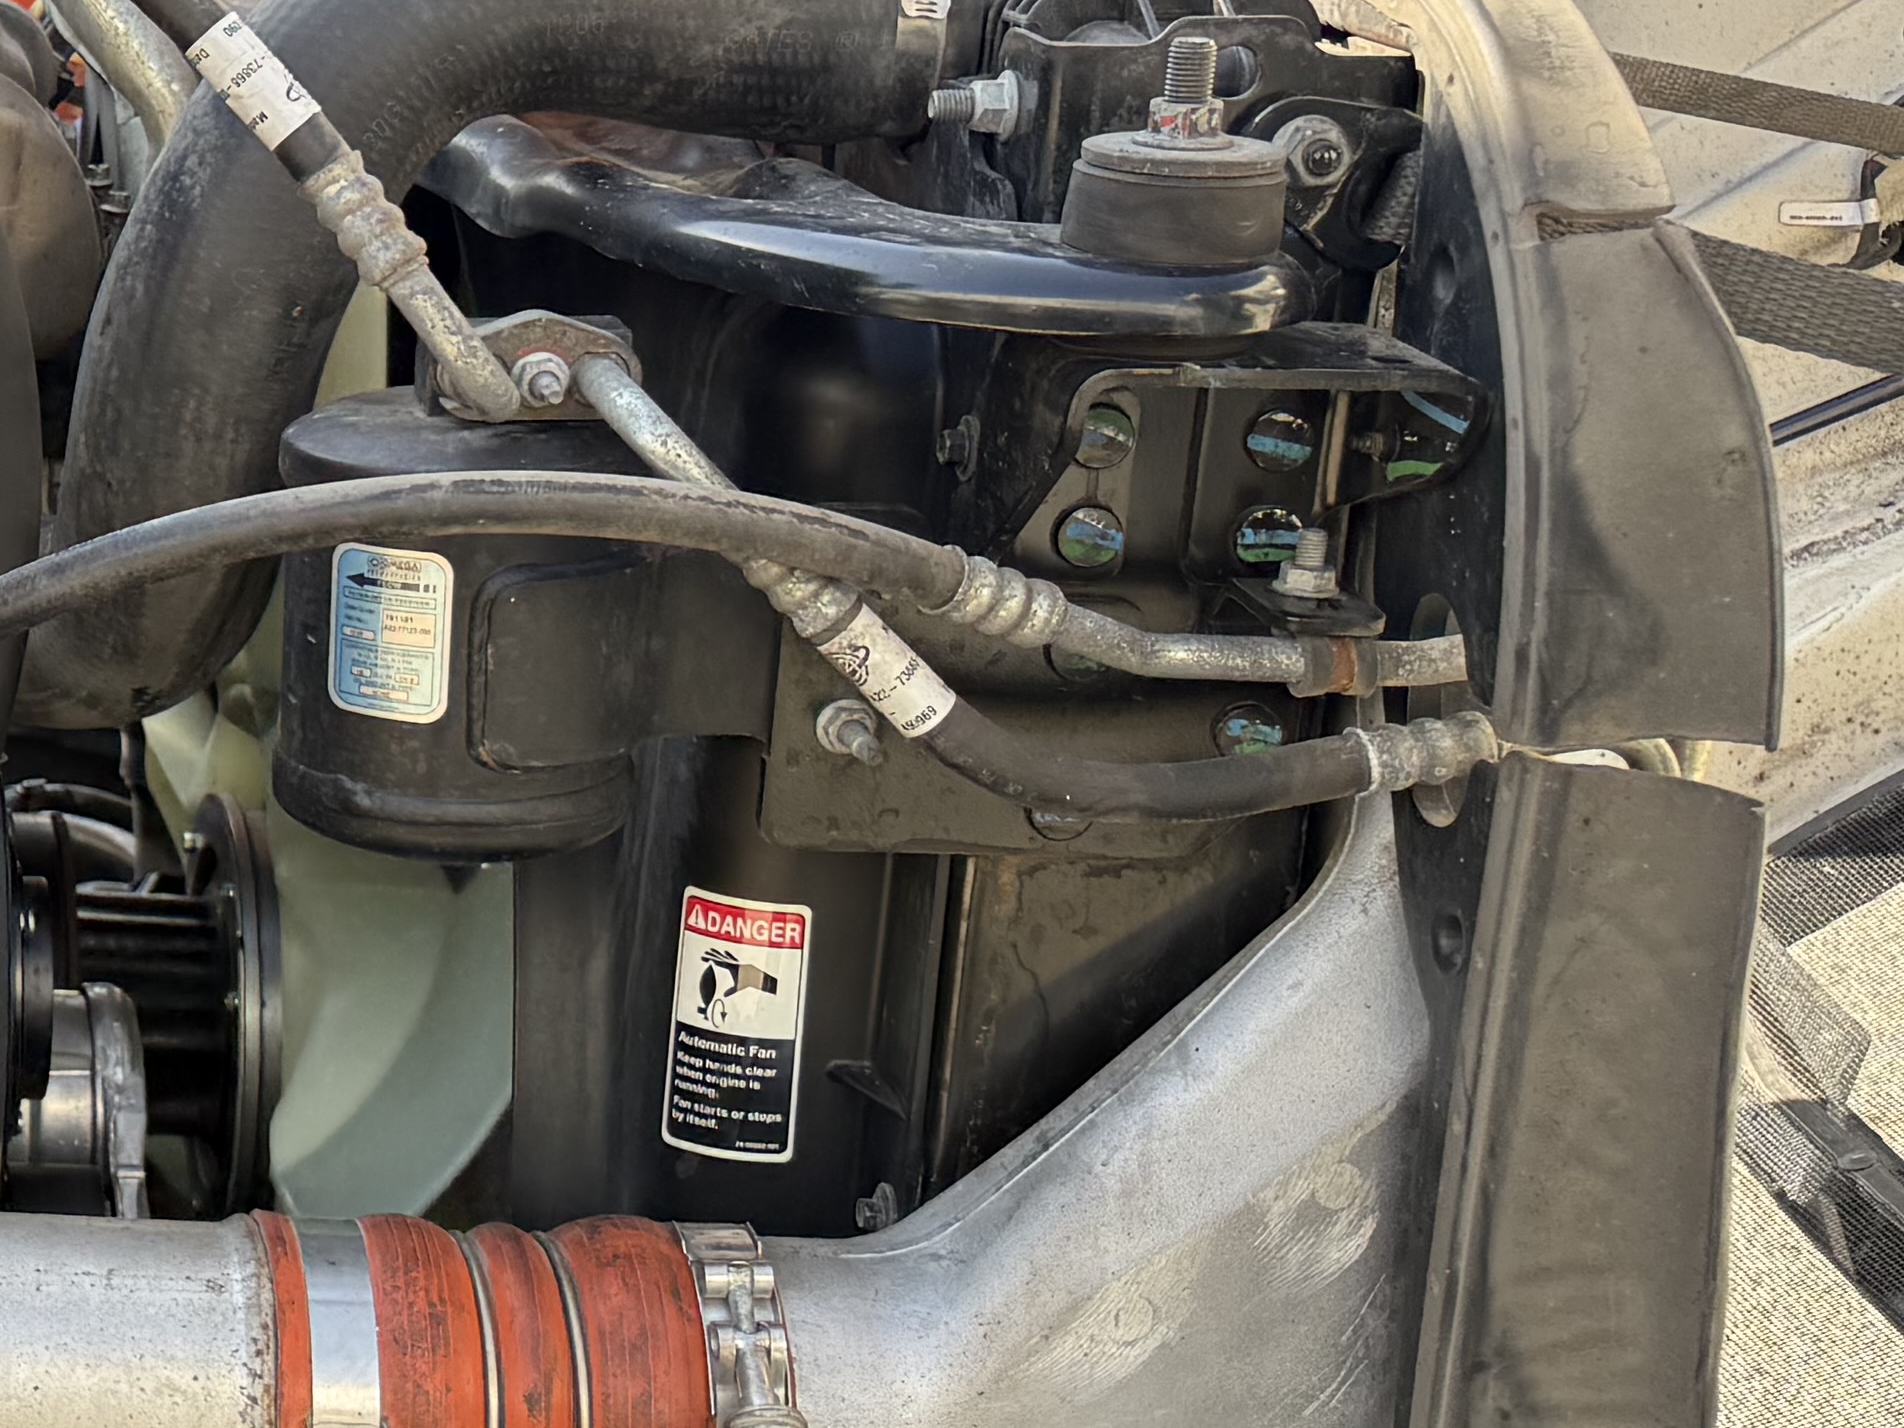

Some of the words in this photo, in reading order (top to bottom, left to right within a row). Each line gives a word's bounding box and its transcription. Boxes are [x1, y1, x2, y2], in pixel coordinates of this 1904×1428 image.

[707, 911, 802, 945] DANGER
[678, 1030, 746, 1057] Automatic
[748, 1045, 777, 1060] Fan
[675, 1065, 703, 1081] when
[705, 1073, 747, 1088] engine
[749, 1079, 761, 1090] is
[676, 1050, 703, 1068] Keep
[705, 1058, 743, 1075] hands
[745, 1066, 778, 1078] clear
[674, 1078, 720, 1100] running.
[671, 1108, 685, 1123] by
[686, 1112, 719, 1130] itself.
[672, 1094, 692, 1110] Fan
[693, 1102, 729, 1118] starts
[730, 1110, 745, 1120] or
[747, 1111, 783, 1125] stops
